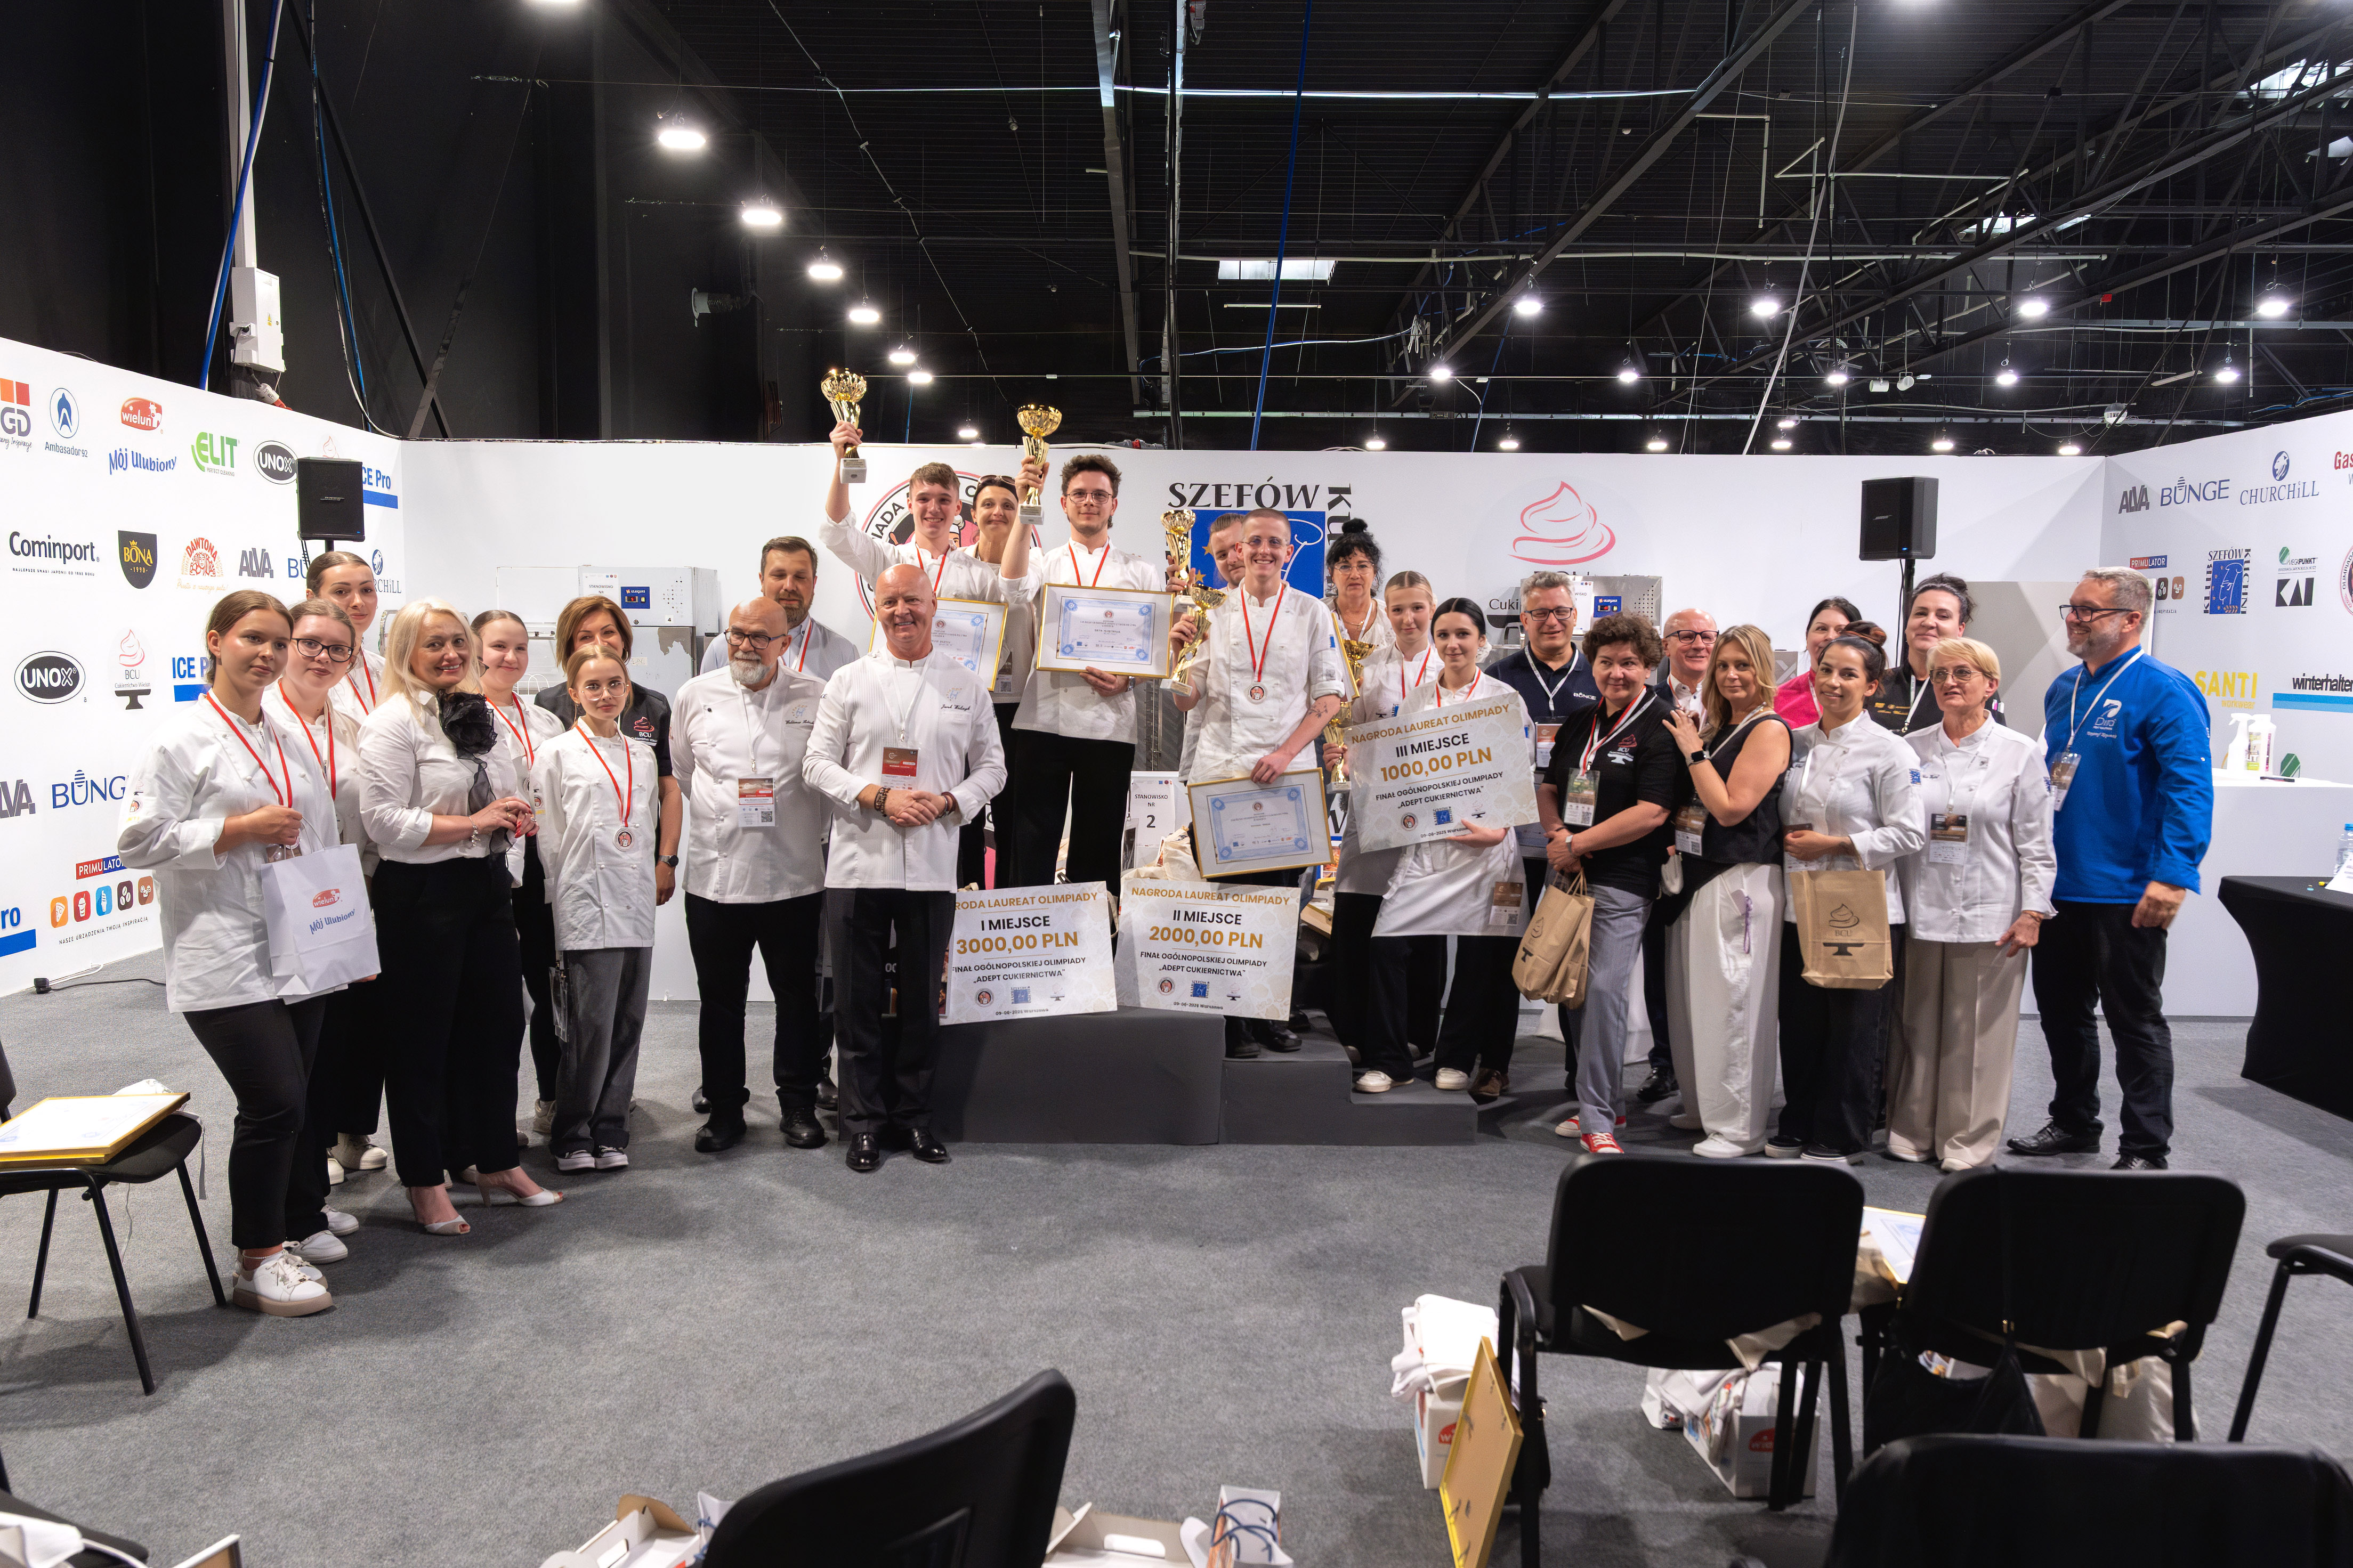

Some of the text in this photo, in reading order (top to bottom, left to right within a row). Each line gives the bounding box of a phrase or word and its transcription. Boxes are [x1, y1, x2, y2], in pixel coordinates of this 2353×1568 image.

[195, 432, 238, 468] ELIT
[109, 448, 176, 475] Mój Ulubiony
[259, 451, 293, 473] UNOX
[362, 466, 391, 489] CE Pro
[1168, 476, 1319, 509] SZEFÓW
[871, 502, 904, 539] IADA
[10, 531, 95, 564] Cominport
[123, 545, 153, 566] BONA
[185, 537, 217, 562] DAWTONA
[2208, 546, 2243, 560] SZEFÓW
[2131, 558, 2165, 567] PRIMULATOR
[2276, 578, 2314, 607] KAI
[23, 667, 73, 688] UNOX
[125, 670, 140, 679] BCU
[173, 657, 196, 678] ICE
[2195, 671, 2258, 698] SANTI
[2292, 673, 2353, 692] winterhalter
[2222, 700, 2255, 709] workwear
[1352, 704, 1509, 744] NAGRODA LAUREAT OLIMPIADY
[1396, 734, 1469, 758] III MIEJSCE
[1380, 747, 1492, 782] 1000,00 PLN
[52, 771, 126, 809] BUNG
[1376, 771, 1503, 801] FINAŁ OGÓLNOPOLSKIEJ OLIMPIADY
[0, 779, 36, 819] VA
[1146, 815, 1155, 828] 2
[956, 892, 1097, 910] RODA LAUREAT OLIMPIADY
[1132, 888, 1289, 905] NAGRODA LAUREAT OLIMPIADY
[0, 907, 21, 929] ro
[324, 908, 355, 925] Ulubiony
[981, 915, 1050, 931] I MIEJSCE
[1173, 910, 1242, 925] II MIEJSCE
[957, 931, 1078, 954] 3000,00 PLN
[1150, 926, 1263, 948] 2000,00 PLN
[974, 960, 1042, 971] OGÓLNOPOLSKIEJ
[1044, 957, 1086, 966] OLIMPIADY
[1162, 952, 1225, 964] OGÓLNOPOLSKIEJ
[1227, 958, 1267, 967] OLIMPIADY
